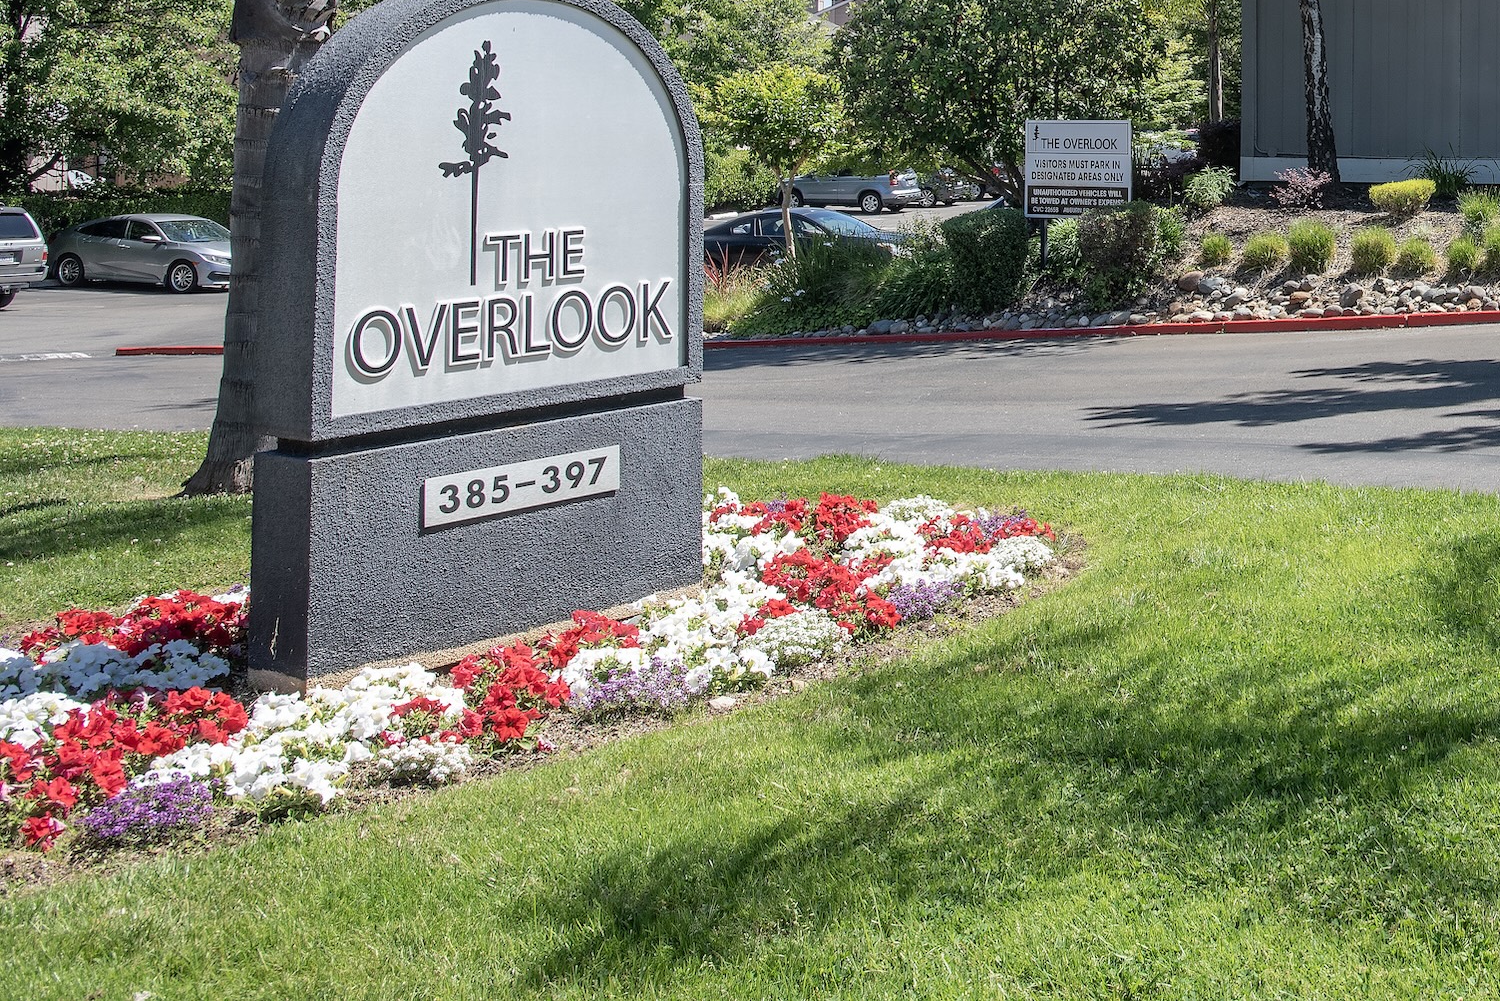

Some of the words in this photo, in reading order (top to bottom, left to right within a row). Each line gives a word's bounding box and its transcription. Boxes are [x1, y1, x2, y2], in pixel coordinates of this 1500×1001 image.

[1041, 138, 1060, 149] THE
[1063, 138, 1118, 150] OVERLOOK
[1034, 159, 1067, 169] VISITORS
[1069, 160, 1089, 169] MUST
[1090, 160, 1110, 170] PARK
[1112, 161, 1120, 170] IN
[1031, 171, 1076, 181] DESIGNATED
[1078, 172, 1102, 181] AREAS
[1104, 173, 1124, 182] ONLY
[1033, 188, 1078, 197] UNAUTHORIZED
[1079, 189, 1107, 198] VEHICLES
[1107, 190, 1122, 198] WILL
[1039, 197, 1060, 205] TOWED
[1069, 198, 1097, 206] OWNER'S
[483, 227, 586, 286] THE
[350, 278, 674, 377] OVERLOOK
